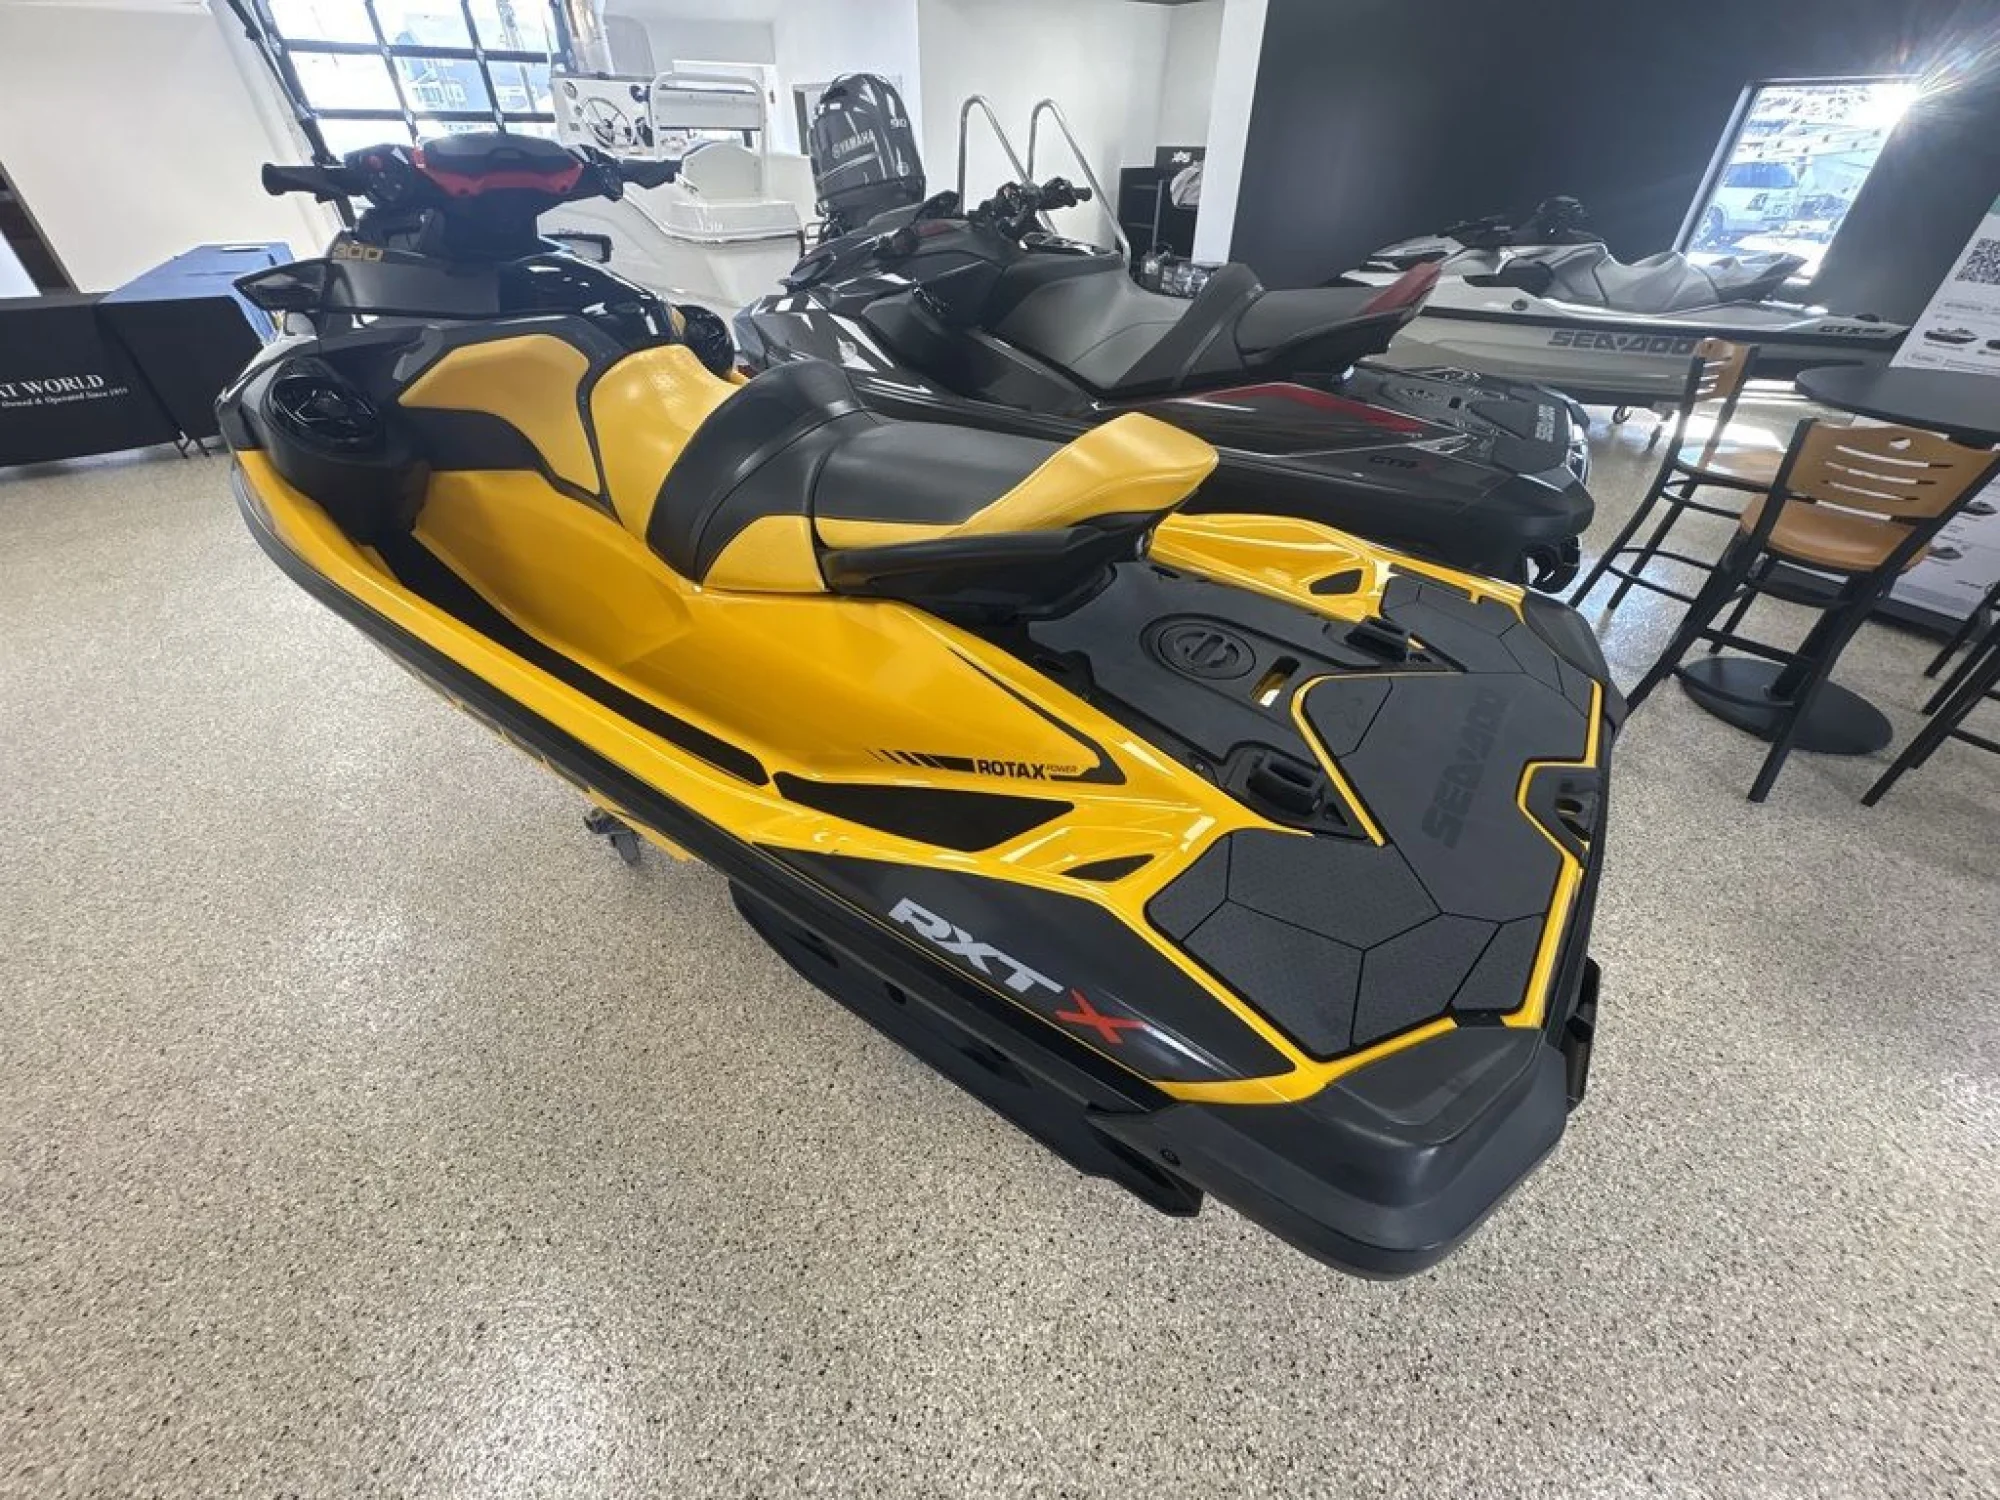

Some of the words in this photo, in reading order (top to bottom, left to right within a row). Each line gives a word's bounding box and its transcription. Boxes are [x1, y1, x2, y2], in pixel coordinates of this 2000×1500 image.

[840, 129, 876, 155] YAMAHA
[21, 374, 104, 395] WORLD
[976, 760, 1046, 780] ROTAX
[888, 897, 1064, 993] RXT
[1055, 987, 1146, 1044] X
